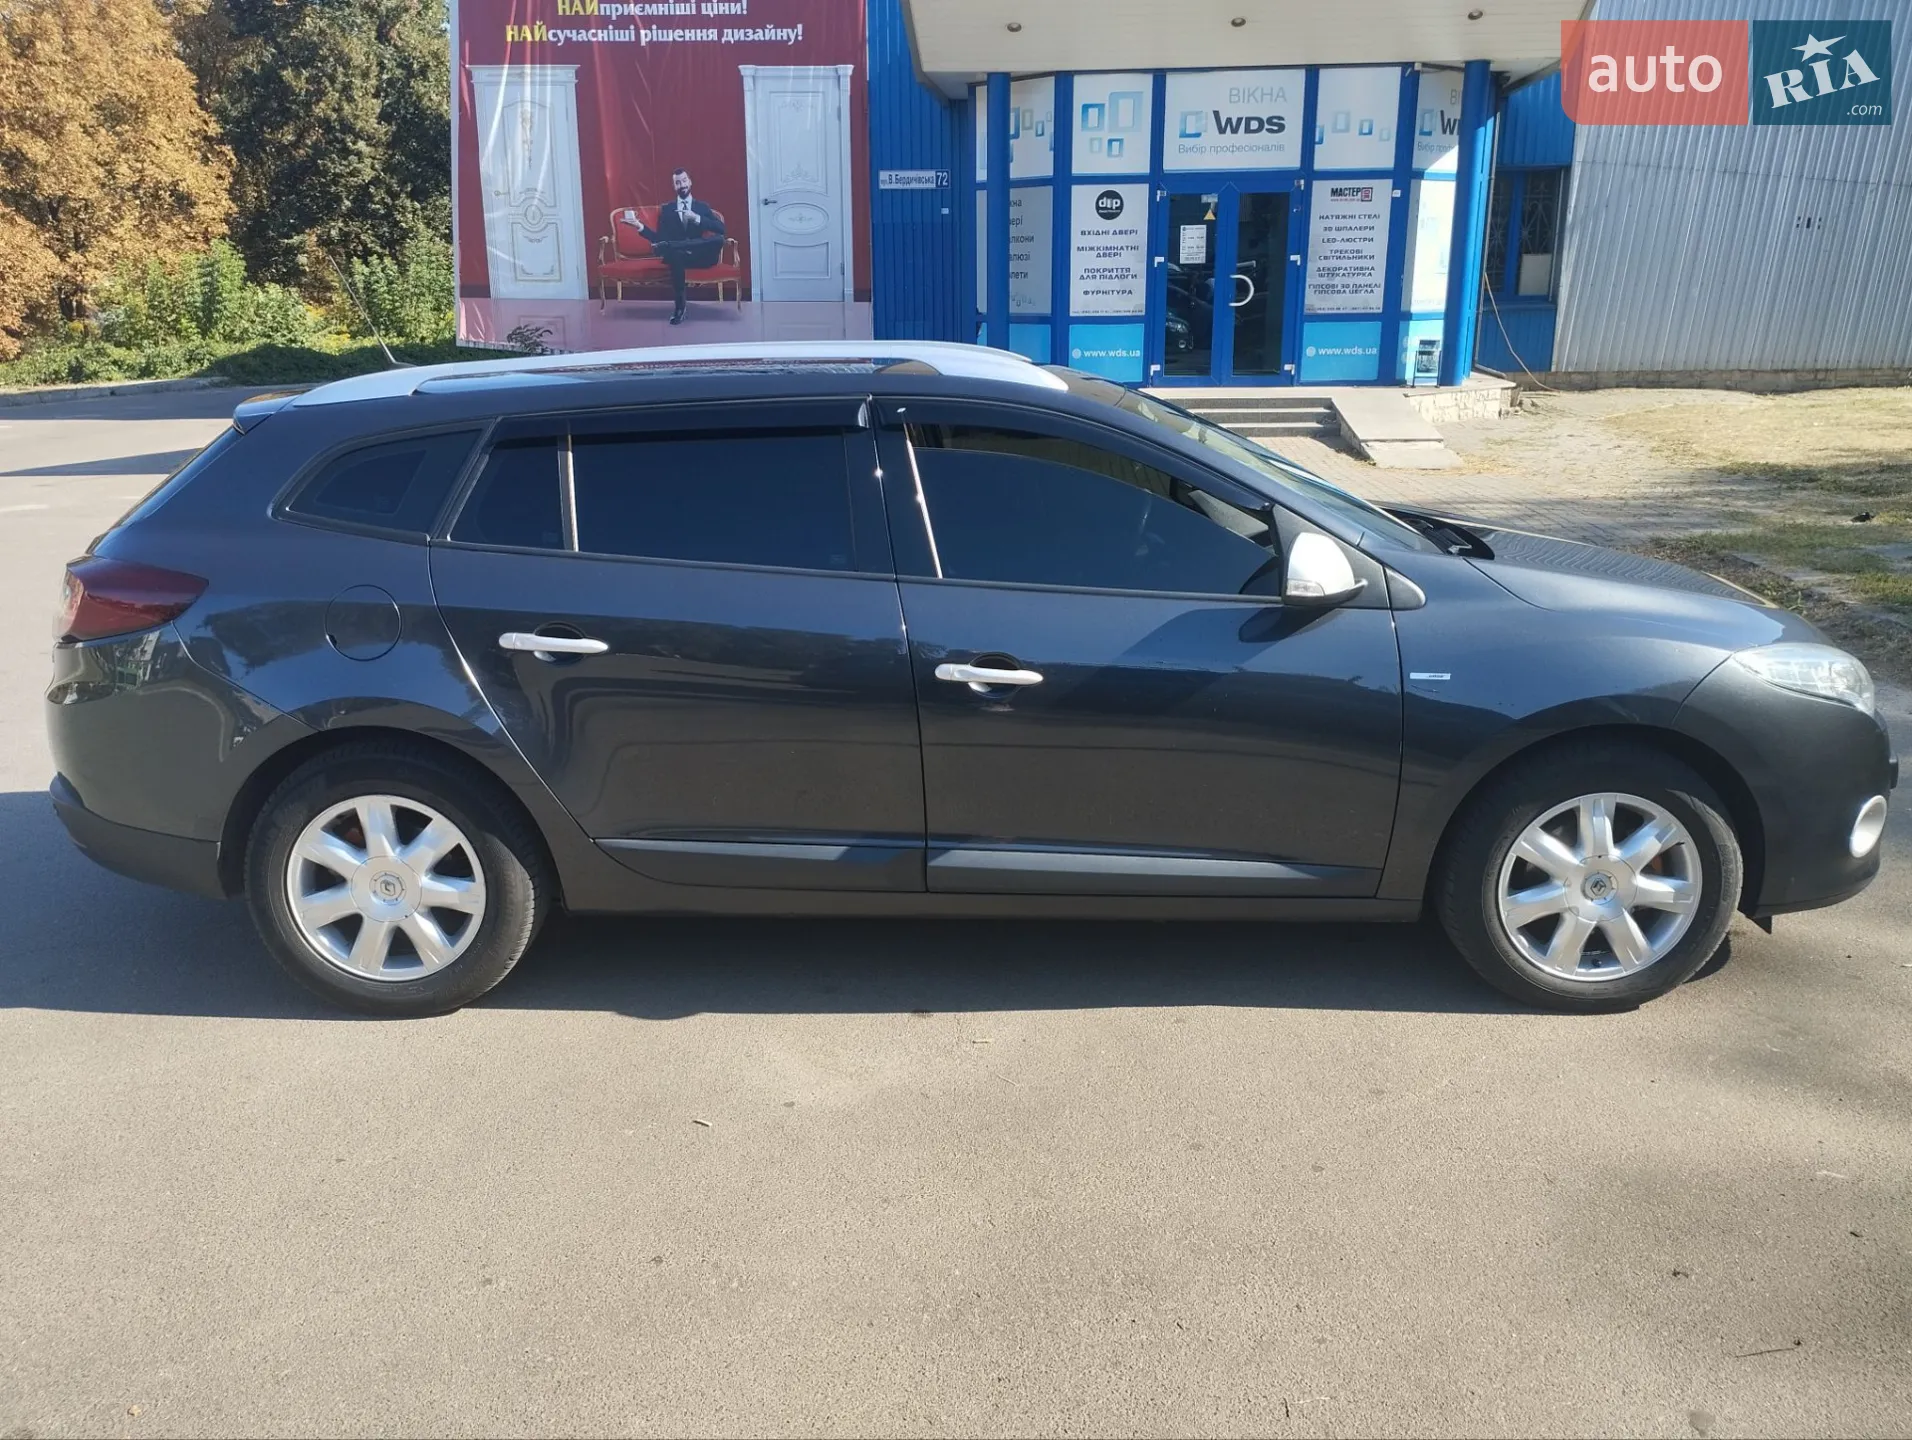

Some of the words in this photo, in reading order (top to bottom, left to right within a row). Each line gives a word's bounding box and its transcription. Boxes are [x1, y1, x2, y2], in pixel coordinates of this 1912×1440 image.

[701, 0, 748, 18] ціни!
[505, 20, 635, 46] НАЙсучасніші
[640, 24, 718, 46] рішення
[721, 23, 803, 45] дизайну!
[1229, 87, 1287, 104] ВІКНА
[1212, 110, 1286, 135] WDS
[1178, 143, 1206, 155] Вибір
[1209, 142, 1285, 155] професіоналів
[937, 172, 949, 186] 72
[1330, 187, 1361, 198] МАСТЕР
[1010, 235, 1034, 244] лкони
[1083, 348, 1140, 357] www.wds.ua
[1318, 345, 1377, 355] www.wds.ua
